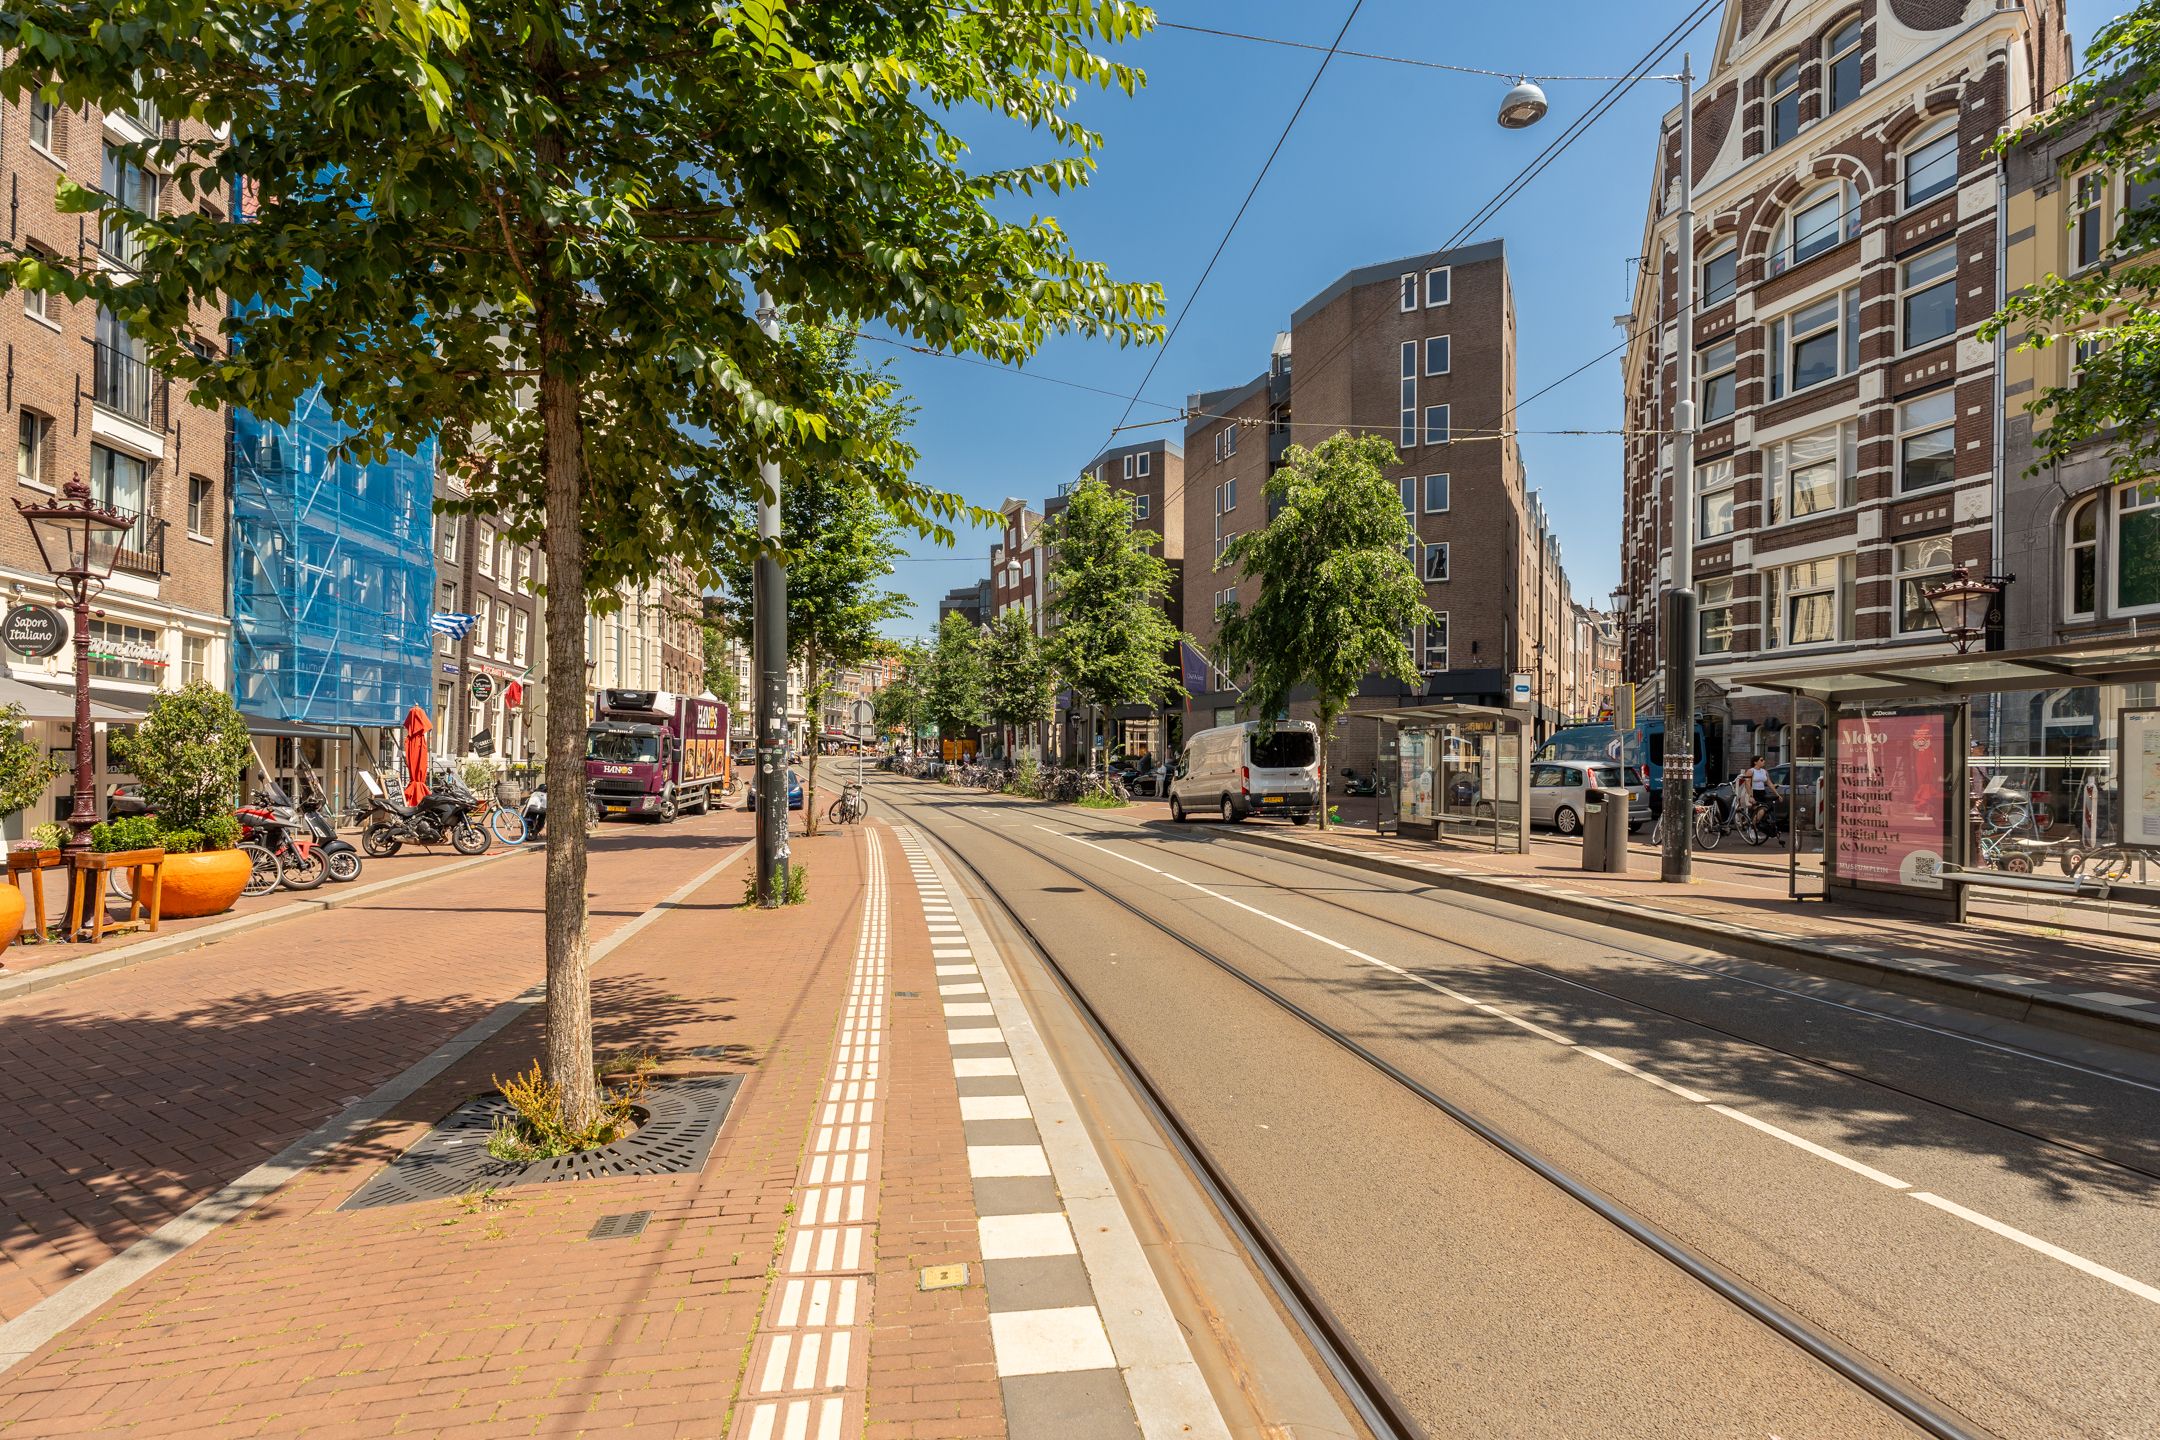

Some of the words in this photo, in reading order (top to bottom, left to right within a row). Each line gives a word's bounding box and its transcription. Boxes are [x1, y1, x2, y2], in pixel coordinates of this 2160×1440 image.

[14, 616, 49, 631] Sapore
[9, 629, 53, 641] Italiano
[1841, 730, 1888, 745] Moco
[1841, 776, 1885, 788] Warhol
[1841, 789, 1893, 803] Basquiat
[1841, 802, 1882, 816] Haring
[1841, 815, 1889, 828] Kusama
[1840, 828, 1878, 841] Digital
[1880, 831, 1901, 843] Art
[1840, 842, 1851, 852] &
[1852, 842, 1888, 855] More!
[1840, 862, 1888, 874] MUSEUMPLEIN
